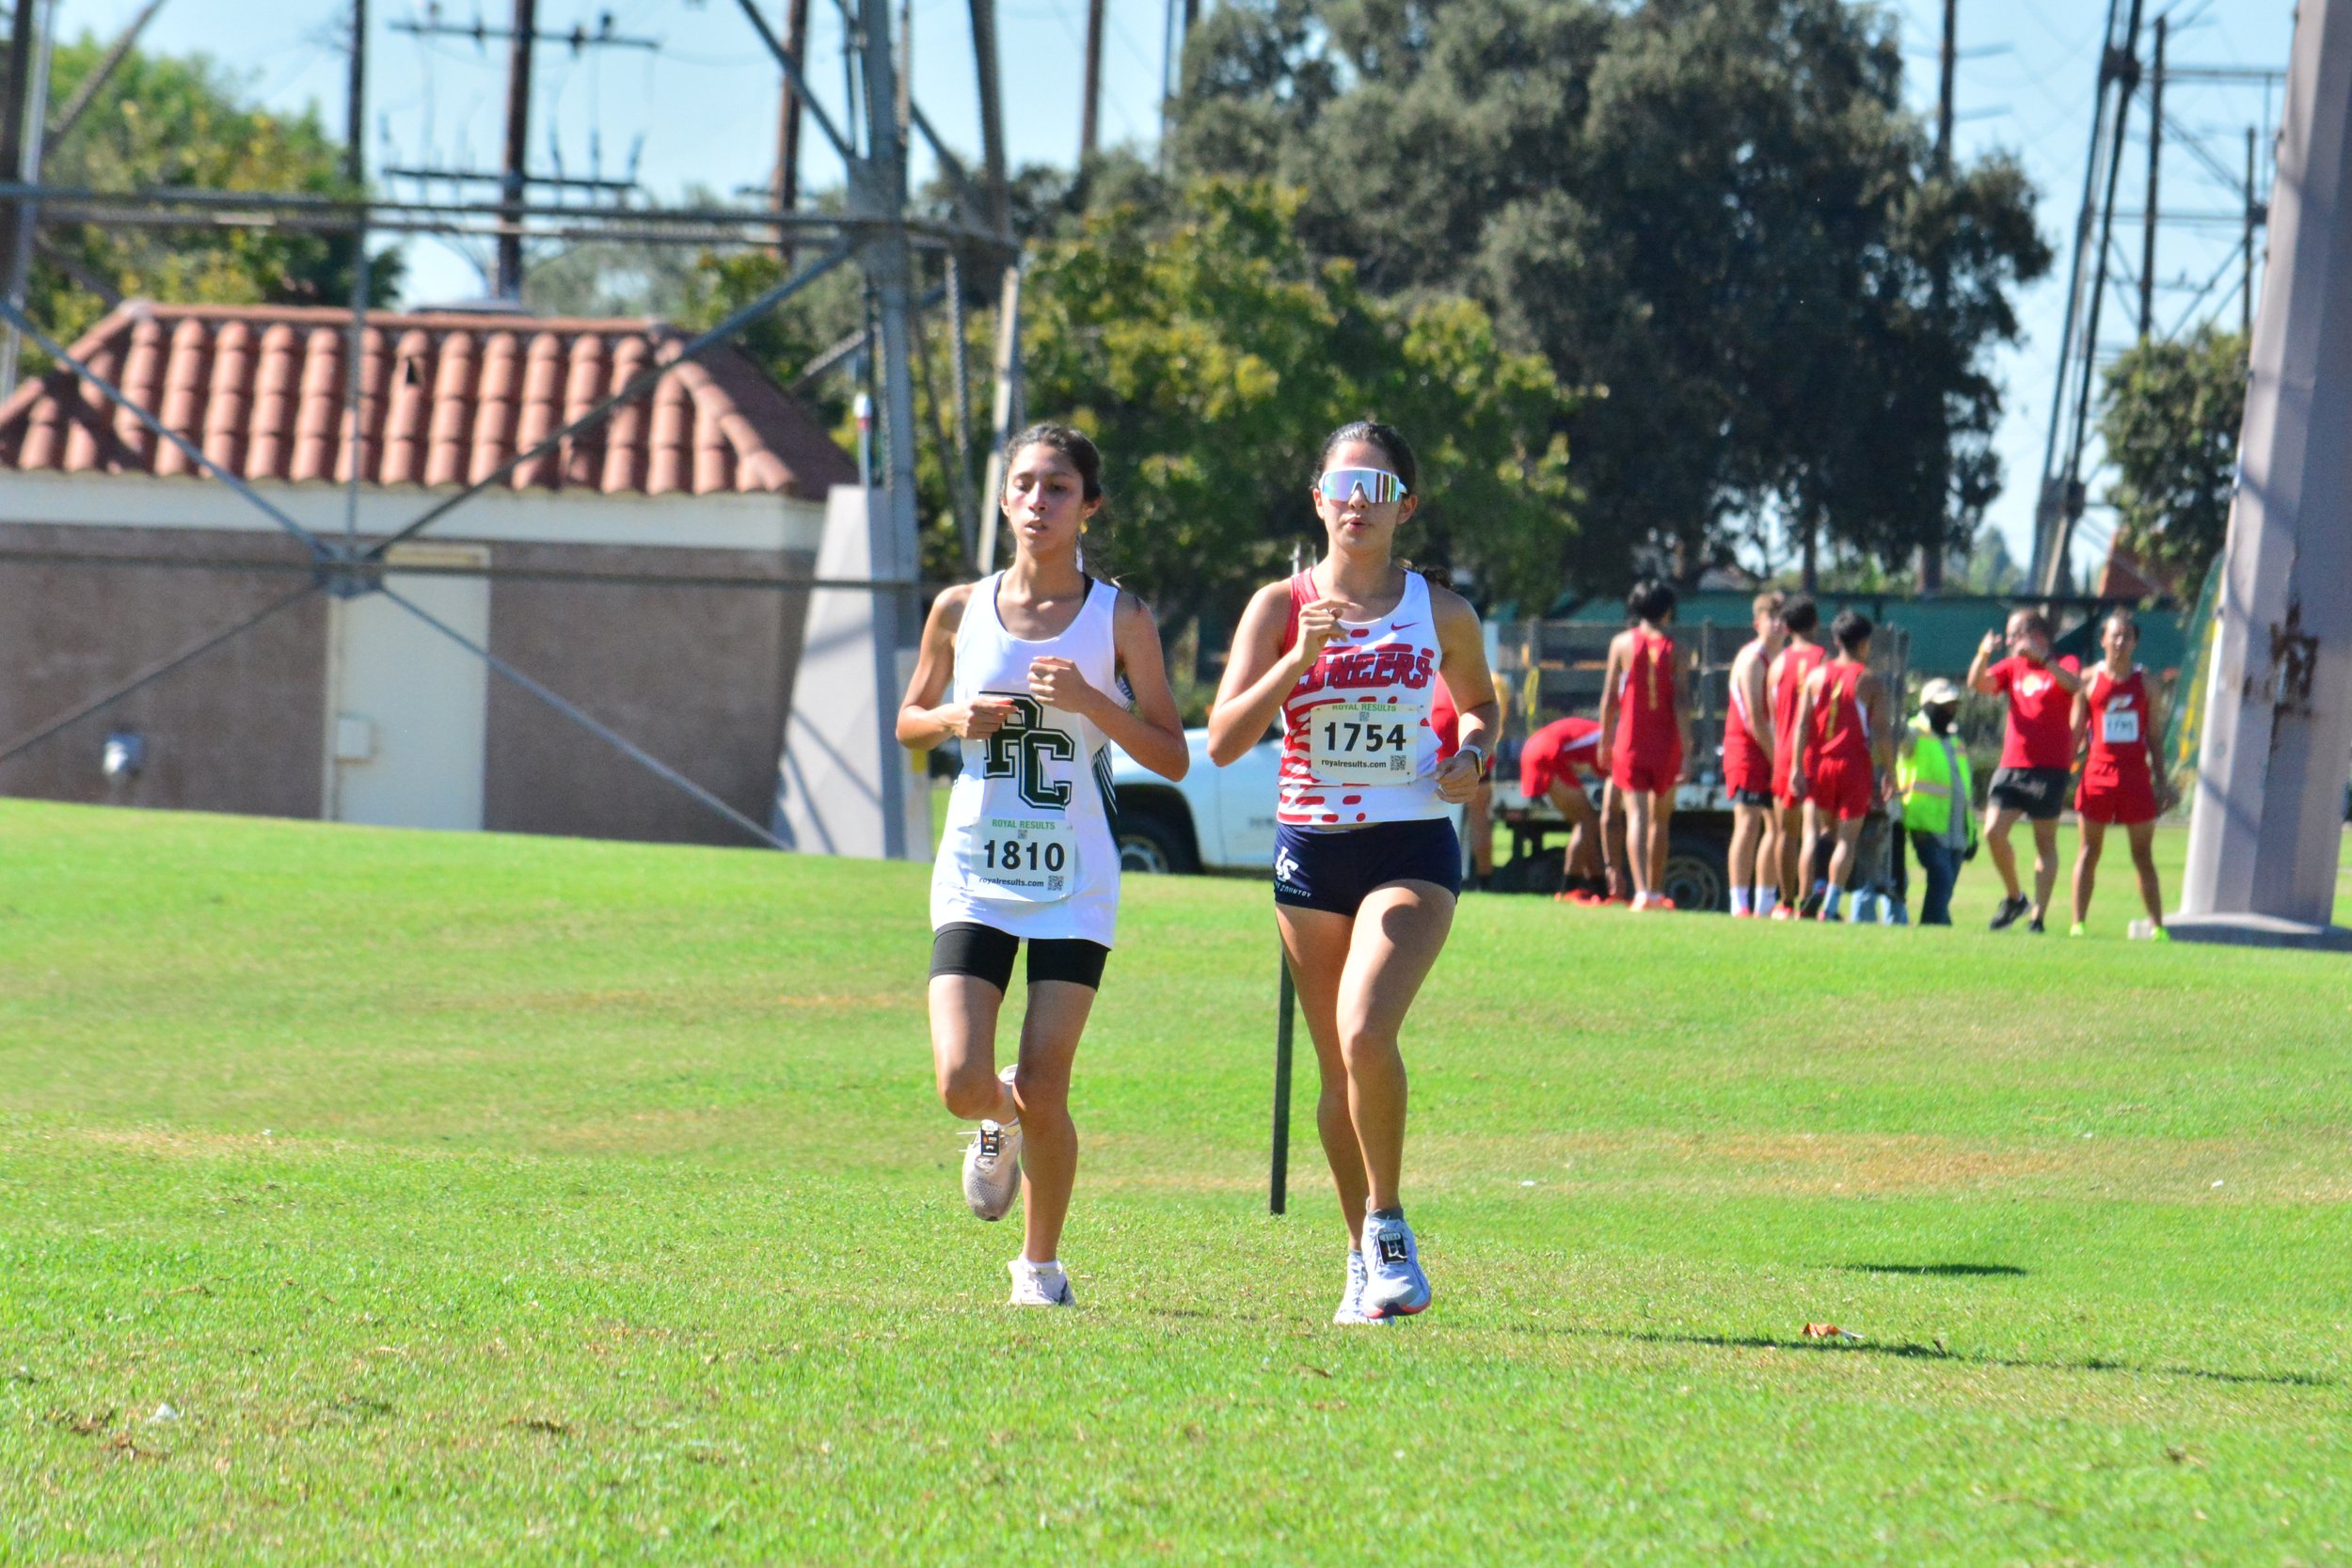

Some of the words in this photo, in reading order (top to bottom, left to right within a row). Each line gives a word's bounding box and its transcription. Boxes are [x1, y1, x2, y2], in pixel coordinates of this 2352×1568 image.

[1361, 704, 1397, 712] RESULTS
[1324, 721, 1406, 752] 1754
[1321, 759, 1387, 768] royalresults.com
[992, 819, 1016, 829] ROYAL
[1019, 820, 1056, 830] RESULTS
[984, 840, 1065, 872] 1810
[979, 877, 1044, 887] royalresults.com
